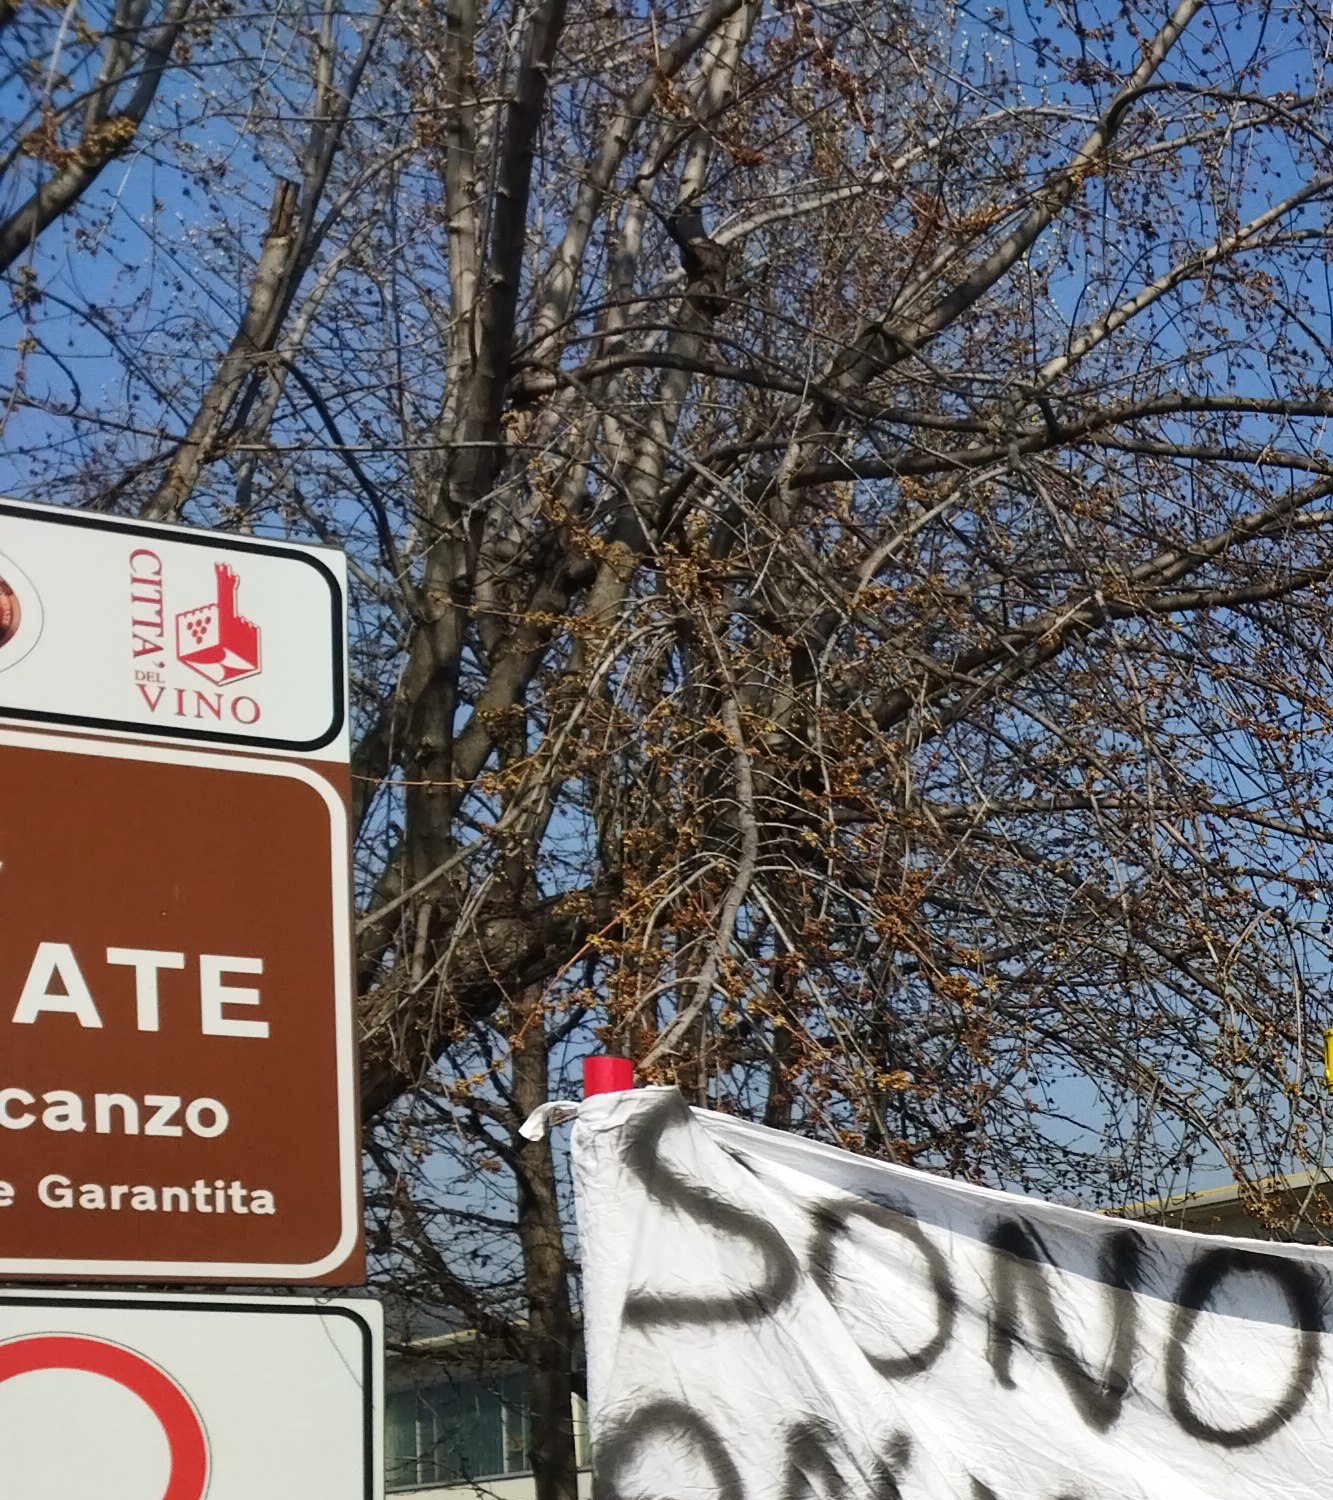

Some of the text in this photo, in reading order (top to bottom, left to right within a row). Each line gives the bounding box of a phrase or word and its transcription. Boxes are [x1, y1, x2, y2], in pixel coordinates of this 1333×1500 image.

[134, 669, 165, 684] DEL
[135, 683, 261, 725] VINO
[37, 1174, 277, 1216] Garantita
[621, 1097, 1328, 1449] SONO
